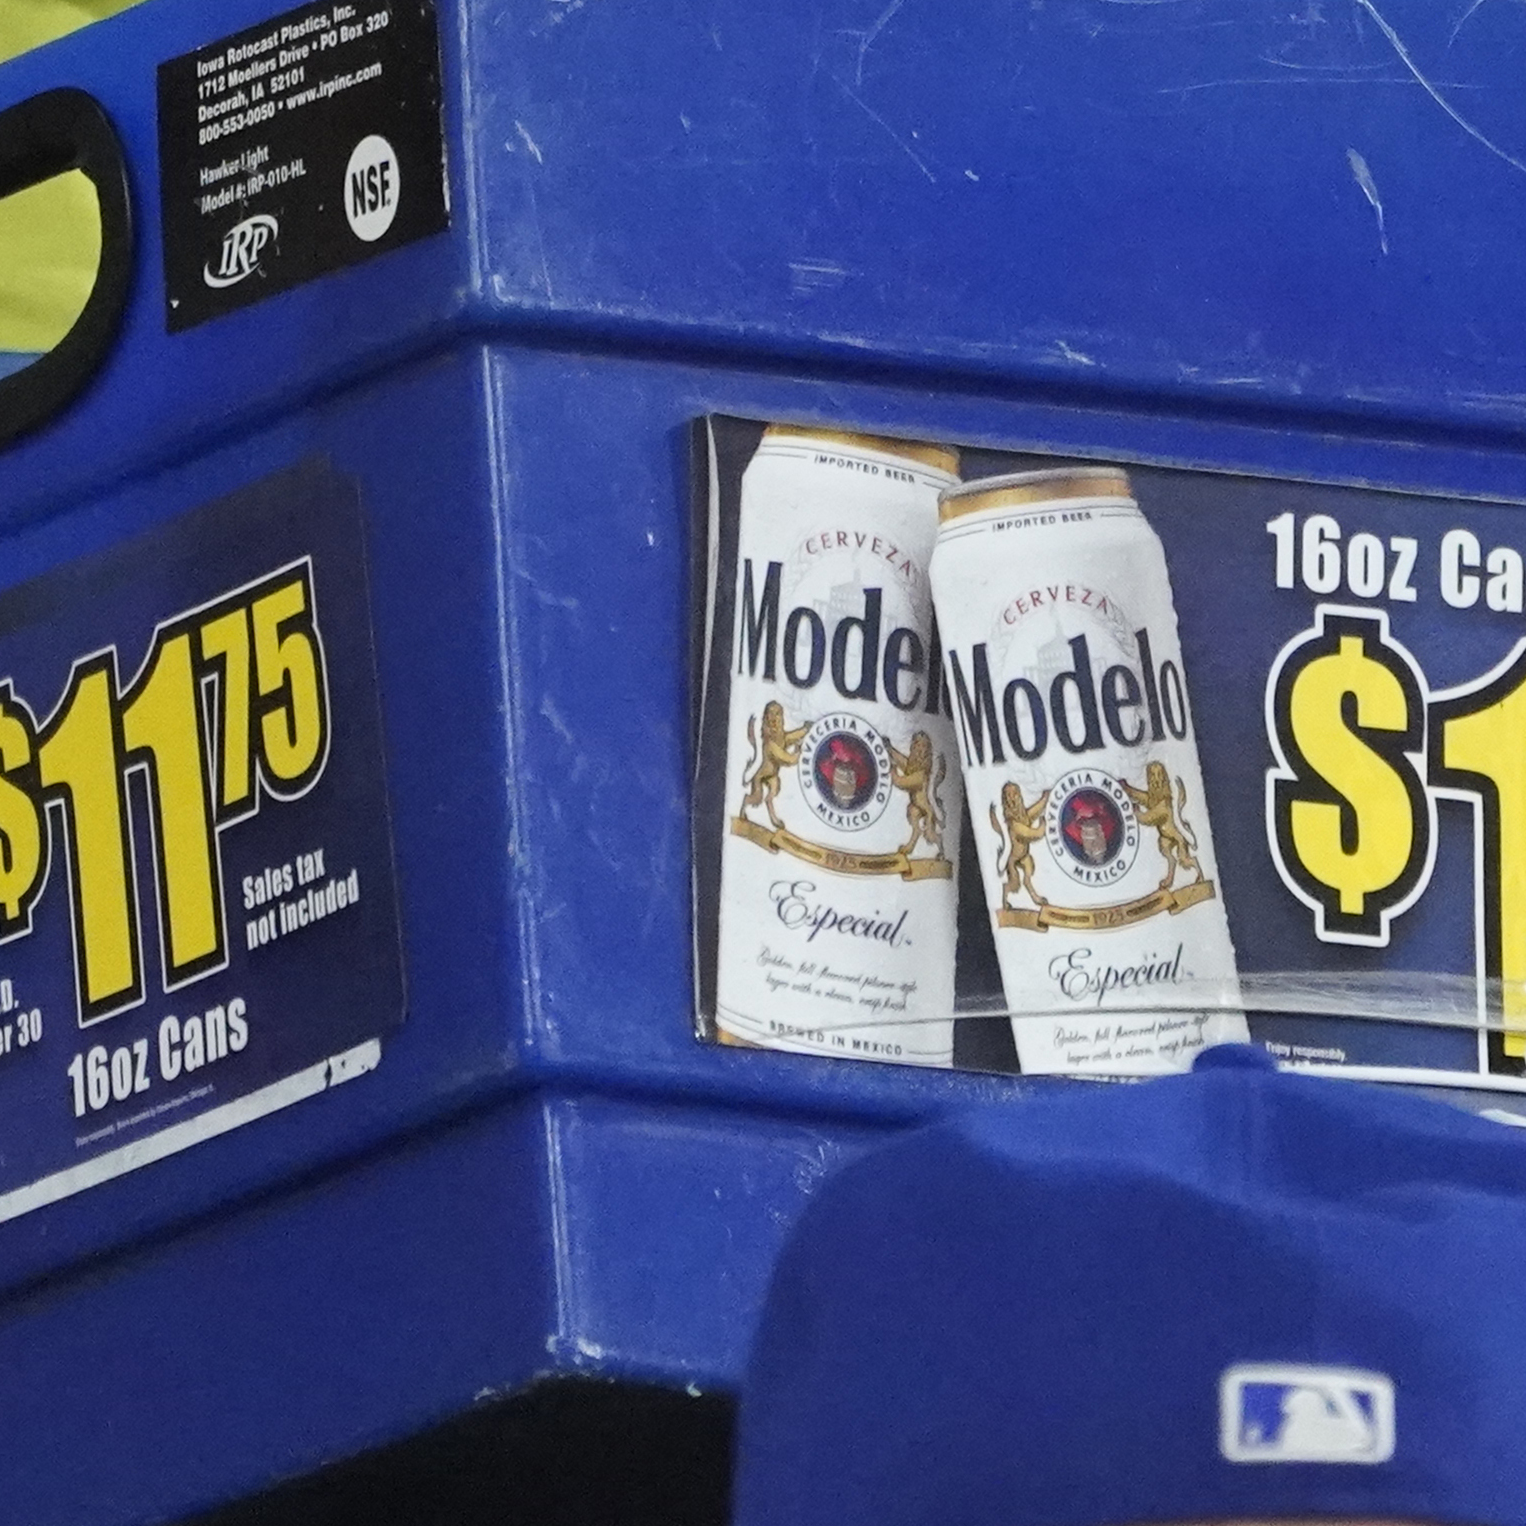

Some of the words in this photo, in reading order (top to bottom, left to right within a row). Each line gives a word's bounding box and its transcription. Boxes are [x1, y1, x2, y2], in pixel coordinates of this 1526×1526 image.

[197, 56, 225, 78] Iowa
[227, 30, 279, 66] Rotocast
[280, 13, 332, 45] Plastics,
[333, 4, 357, 21] Inc.
[198, 75, 226, 100] 1712
[228, 53, 277, 89] Moellers
[279, 43, 310, 67] Drive
[320, 30, 338, 51] PO
[340, 23, 364, 44] Box
[366, 10, 390, 34] 320
[198, 89, 250, 123] Decorah,
[251, 81, 265, 102] IA
[270, 66, 305, 95] 52101
[198, 101, 276, 145] 800-553-0050
[286, 61, 383, 110] www.irpinc.com
[200, 158, 240, 187] Hawker
[240, 145, 270, 171] Light
[201, 187, 235, 215] Model
[247, 157, 307, 197] IRP-010-HL
[351, 159, 391, 220] NSF
[218, 223, 269, 276] IRP
[815, 454, 879, 475] IMPORTED
[885, 469, 916, 484] BEER
[992, 515, 1056, 532] IMPORTED
[1062, 512, 1092, 523] BEER
[805, 530, 912, 577] CERVEZA
[1266, 512, 1417, 603] 16oz
[1003, 584, 1110, 626] CERVEZA
[738, 558, 954, 722] Model
[948, 627, 1186, 768] Modelo
[816, 802, 872, 827] MEXICO
[242, 866, 295, 911] Sales
[296, 848, 326, 884] tax
[1073, 858, 1127, 883] MEXICO
[246, 910, 278, 952] not
[279, 870, 361, 937] included
[768, 879, 909, 949] Especial
[1047, 942, 1186, 1008] Especial
[18, 1008, 44, 1050] 30
[67, 1037, 151, 1119] 16oz
[158, 997, 249, 1081] Cans
[831, 1036, 846, 1048] IN
[852, 1039, 904, 1057] MEXICO
